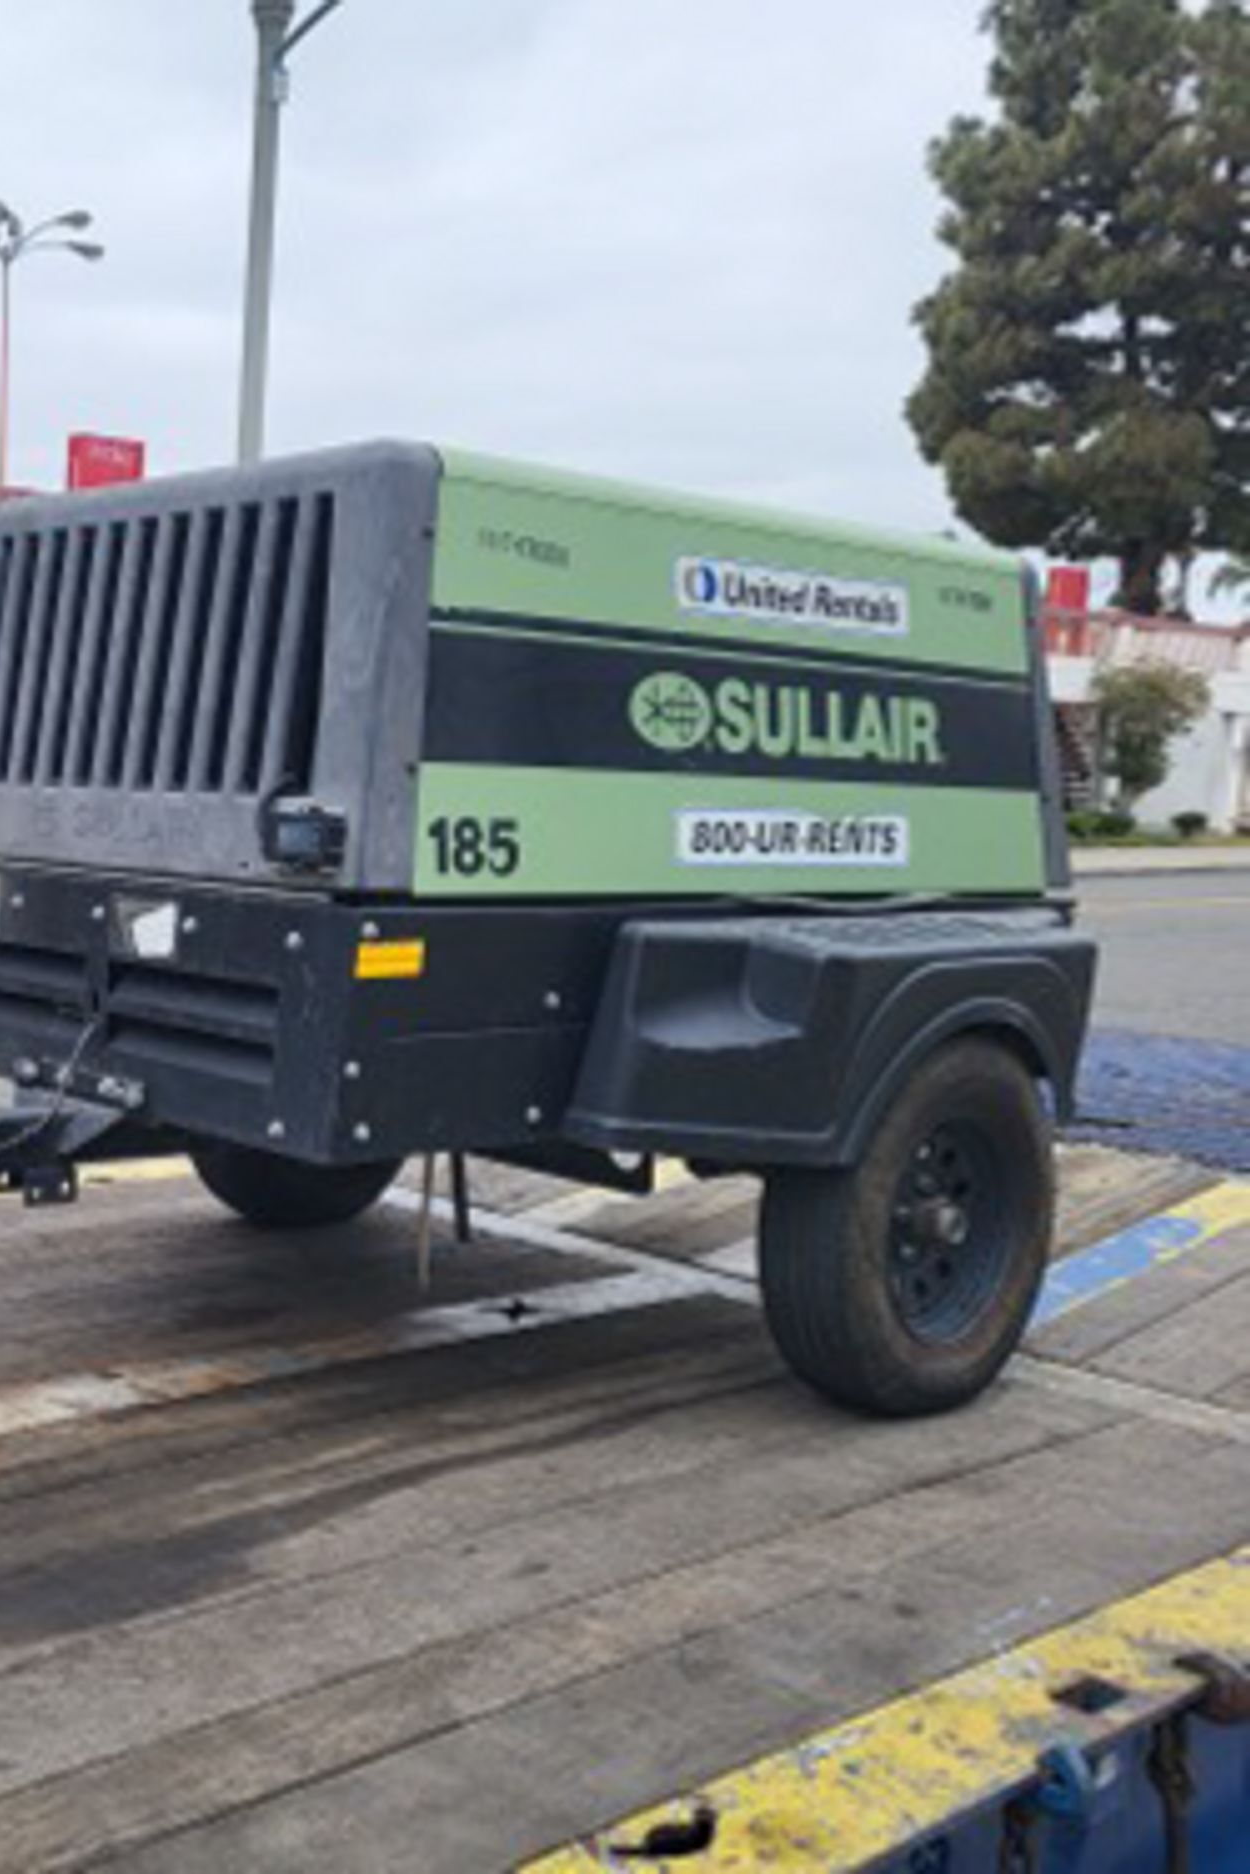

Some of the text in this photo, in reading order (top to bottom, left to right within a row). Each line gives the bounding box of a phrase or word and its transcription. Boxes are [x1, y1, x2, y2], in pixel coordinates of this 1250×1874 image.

[724, 571, 810, 613] United
[813, 582, 899, 625] Rentals
[715, 676, 943, 764] SULLAIR
[427, 816, 520, 877] 185
[691, 820, 898, 854] 800-UR-RENTS
